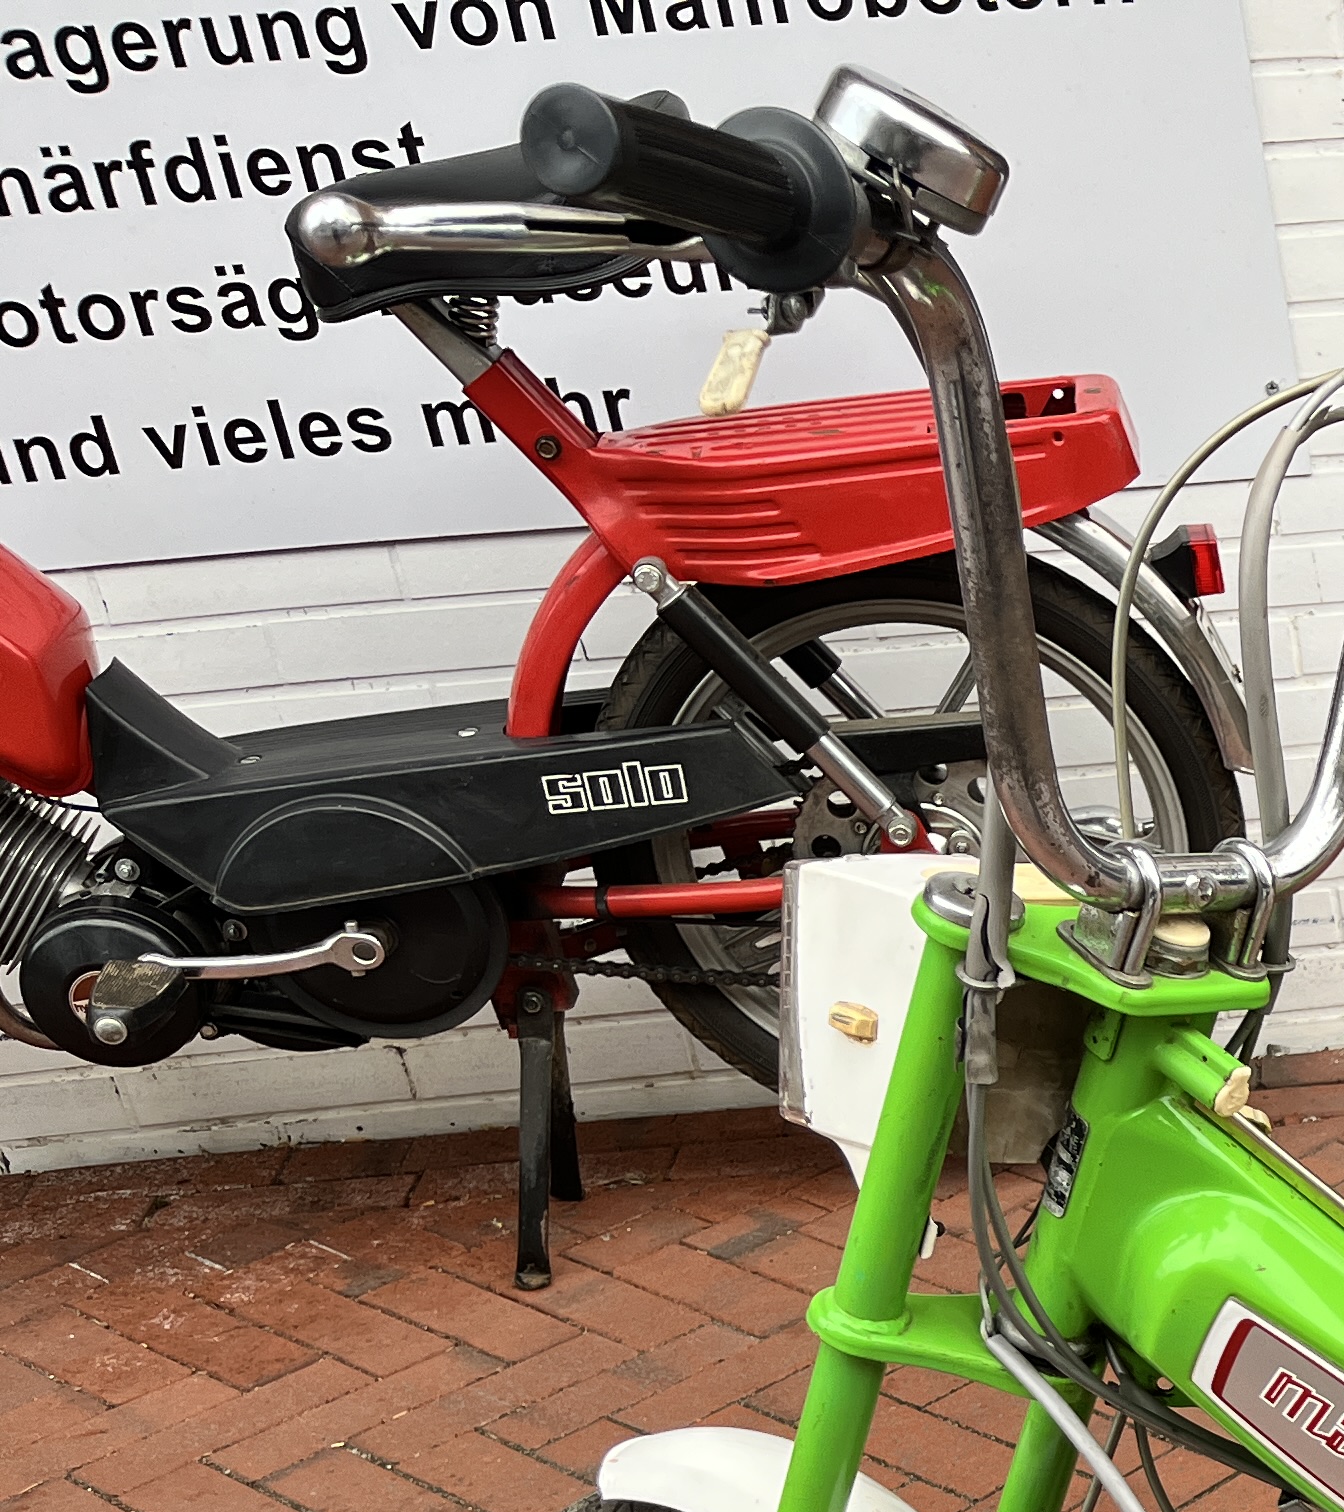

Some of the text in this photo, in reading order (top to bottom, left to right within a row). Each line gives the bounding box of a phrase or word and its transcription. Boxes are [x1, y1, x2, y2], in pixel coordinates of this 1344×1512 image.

[389, 0, 556, 49] von
[0, 377, 631, 485] nd vieles mhr
[541, 760, 689, 815] solo
